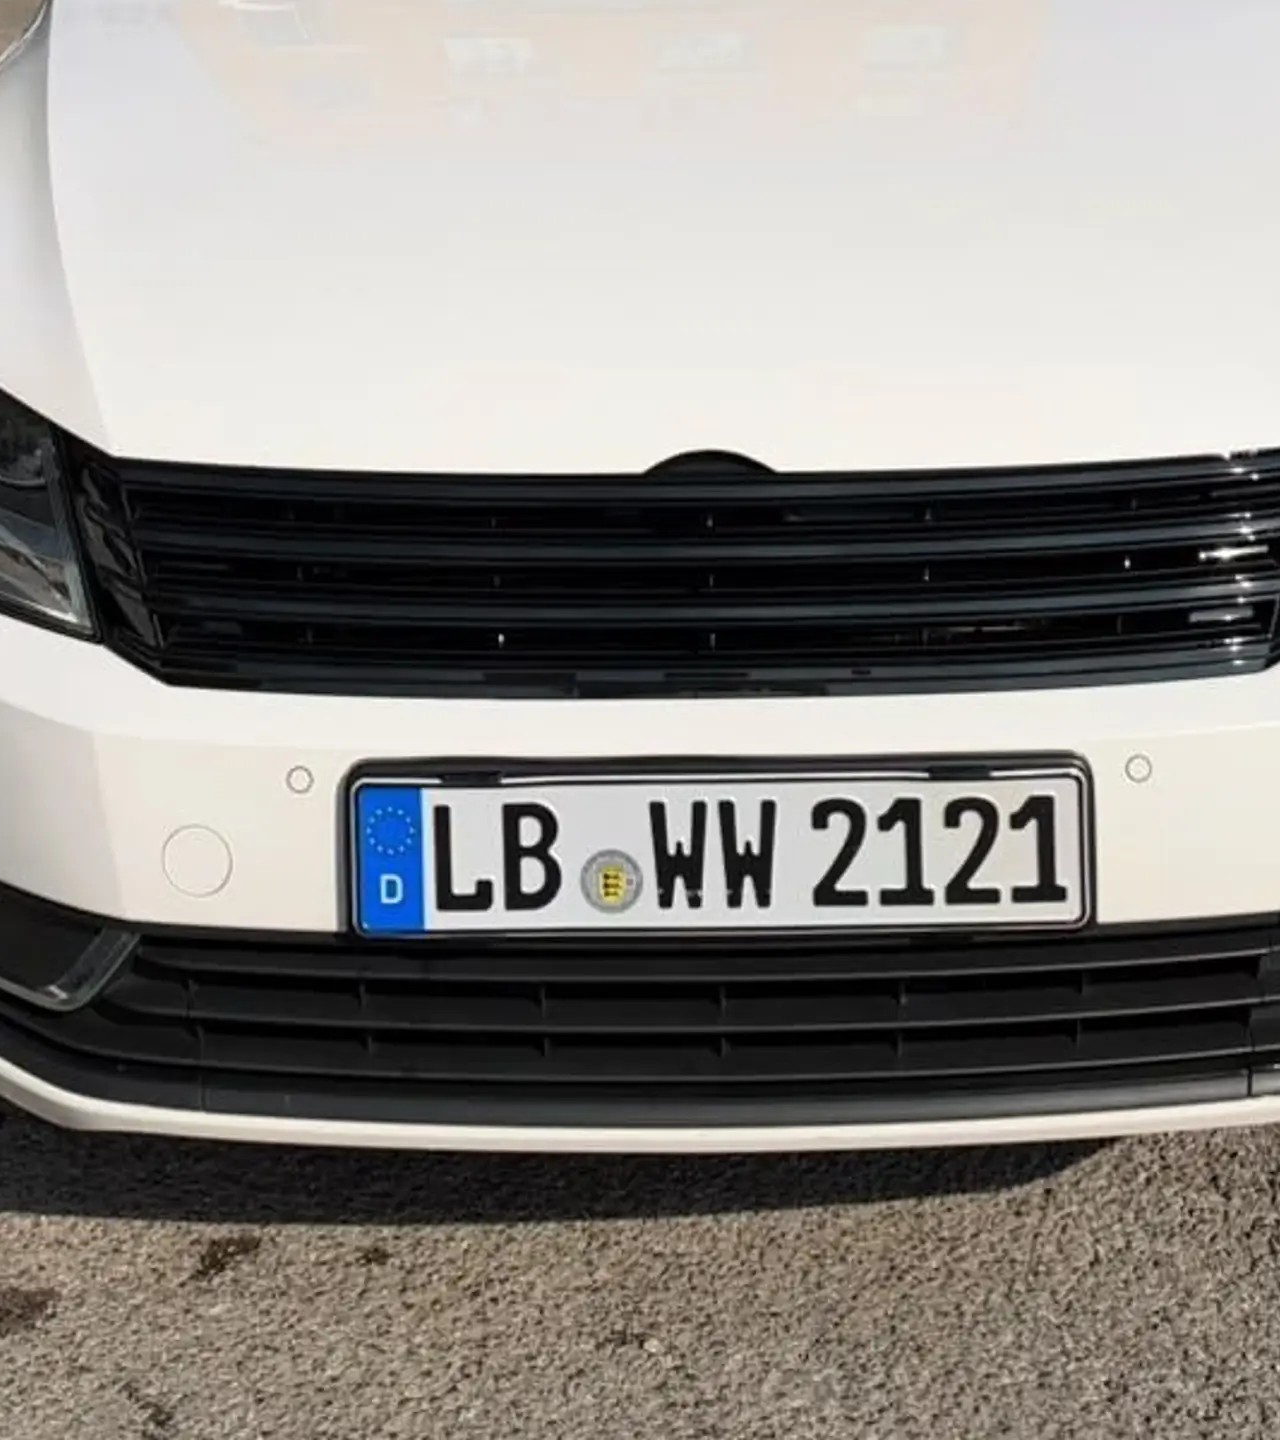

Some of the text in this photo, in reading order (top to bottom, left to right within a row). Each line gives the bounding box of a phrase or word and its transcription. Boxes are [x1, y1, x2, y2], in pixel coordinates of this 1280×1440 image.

[381, 874, 404, 904] D
[433, 795, 1066, 911] LB WW 2121
